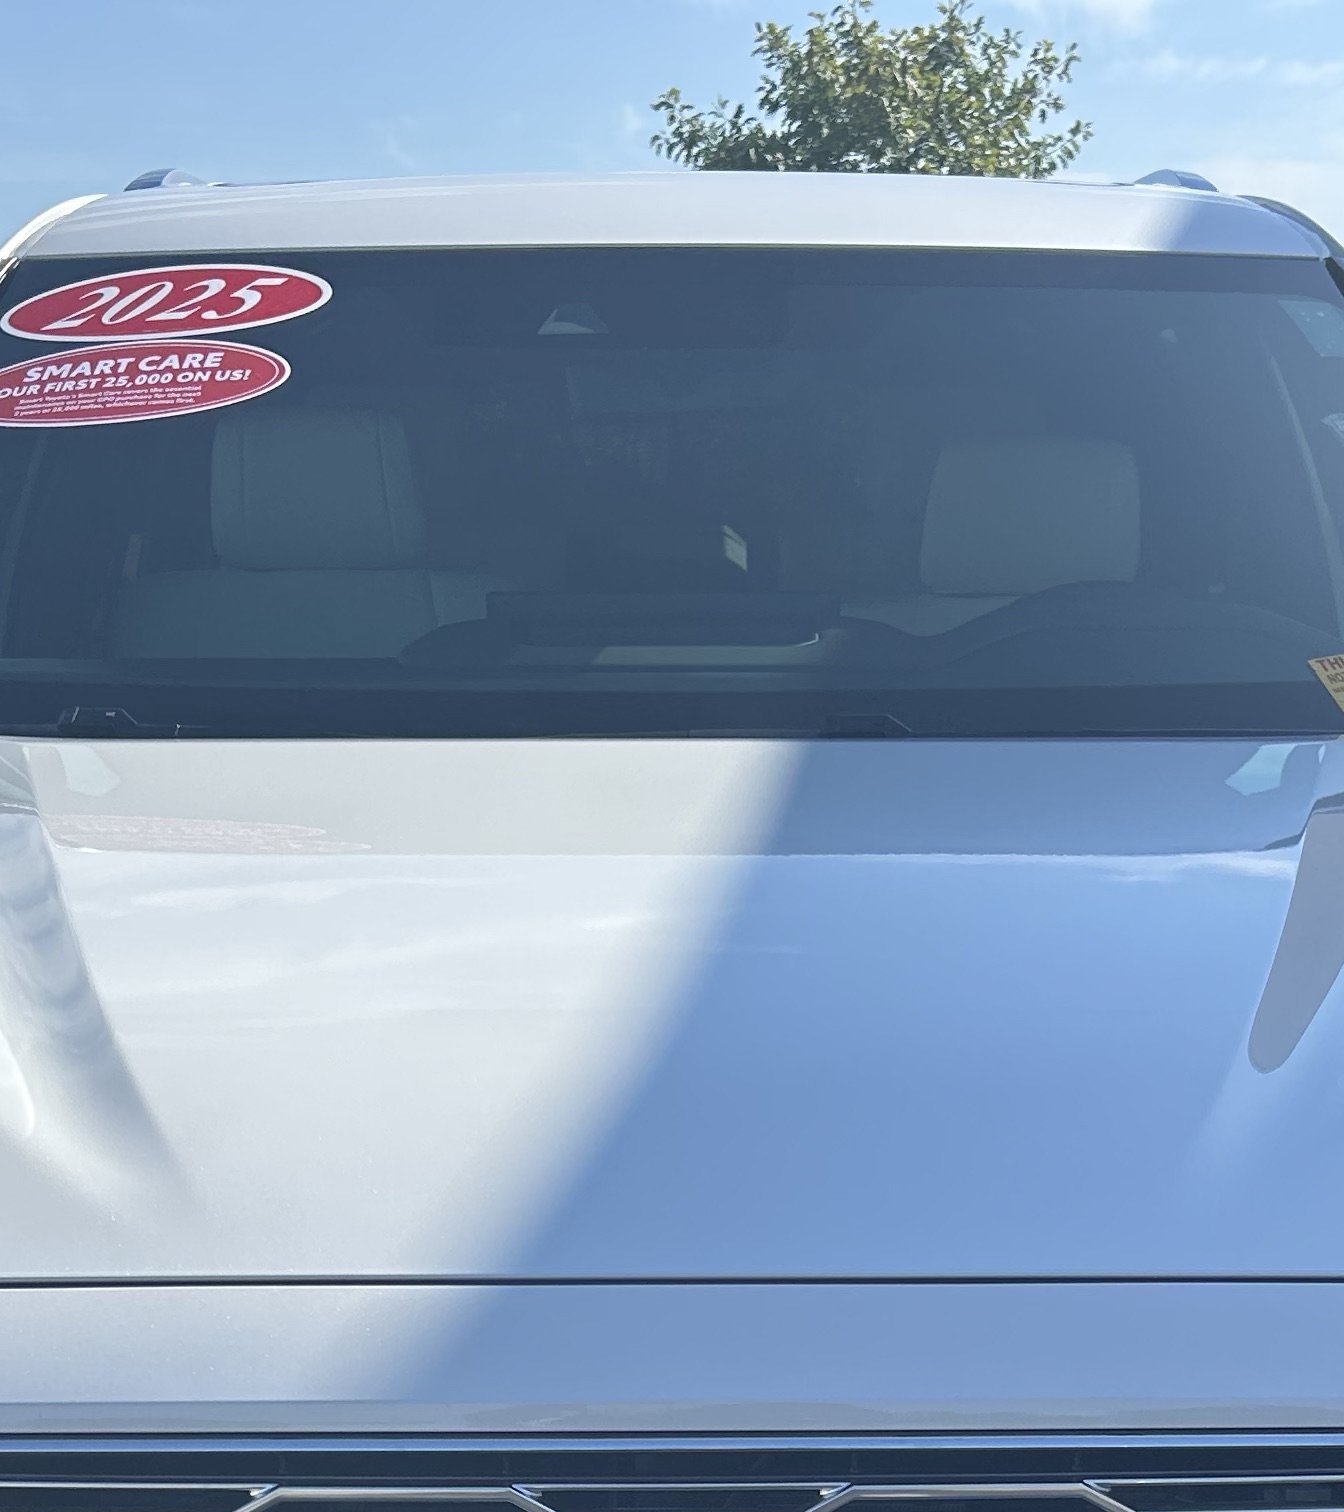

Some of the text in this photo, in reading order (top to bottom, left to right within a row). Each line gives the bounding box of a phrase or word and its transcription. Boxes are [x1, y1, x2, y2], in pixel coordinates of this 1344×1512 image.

[40, 277, 289, 331] 2025
[22, 351, 225, 383] SMART CARE
[44, 377, 102, 394] FIRST
[103, 373, 171, 389] 25,000
[177, 369, 209, 382] ON
[213, 368, 252, 381] US!
